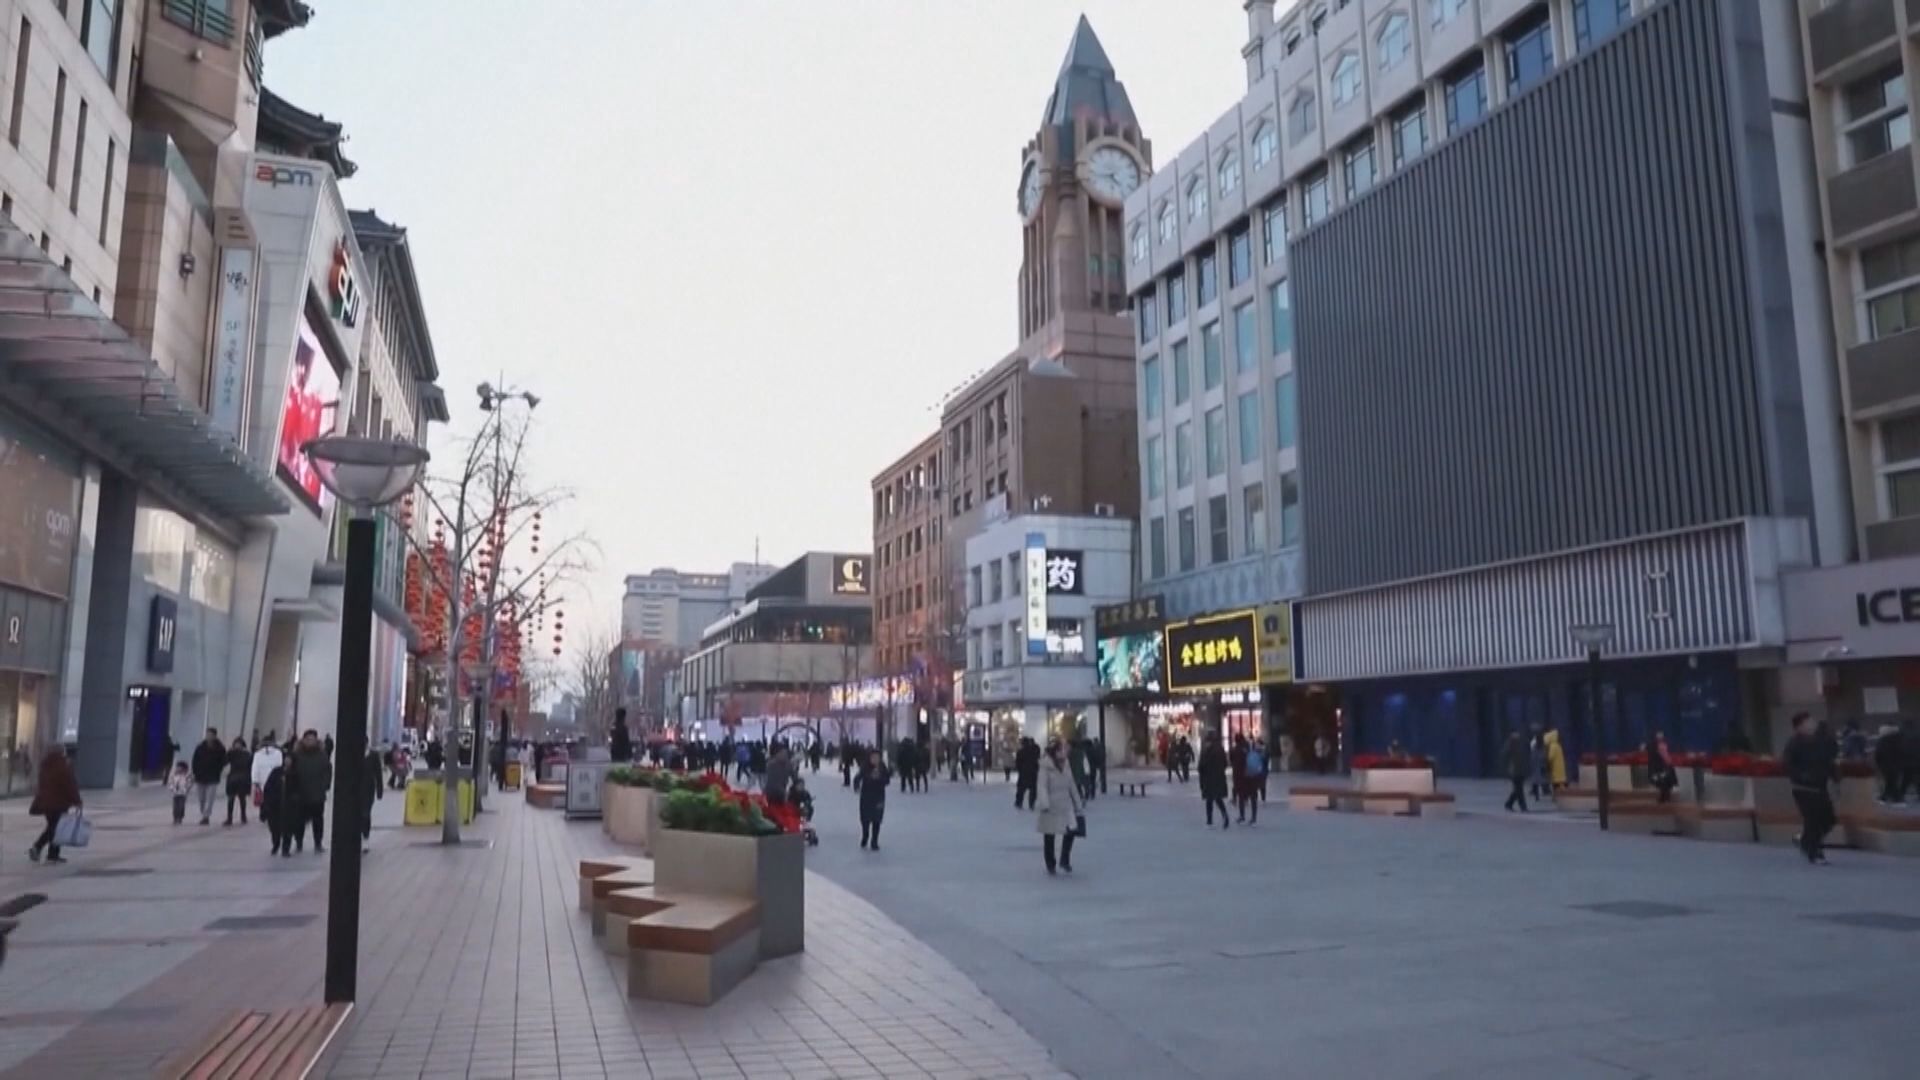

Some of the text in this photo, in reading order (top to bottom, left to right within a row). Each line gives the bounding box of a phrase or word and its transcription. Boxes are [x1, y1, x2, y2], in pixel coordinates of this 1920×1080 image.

[255, 164, 313, 189] apm
[842, 559, 863, 581] C
[1046, 555, 1078, 591] 药
